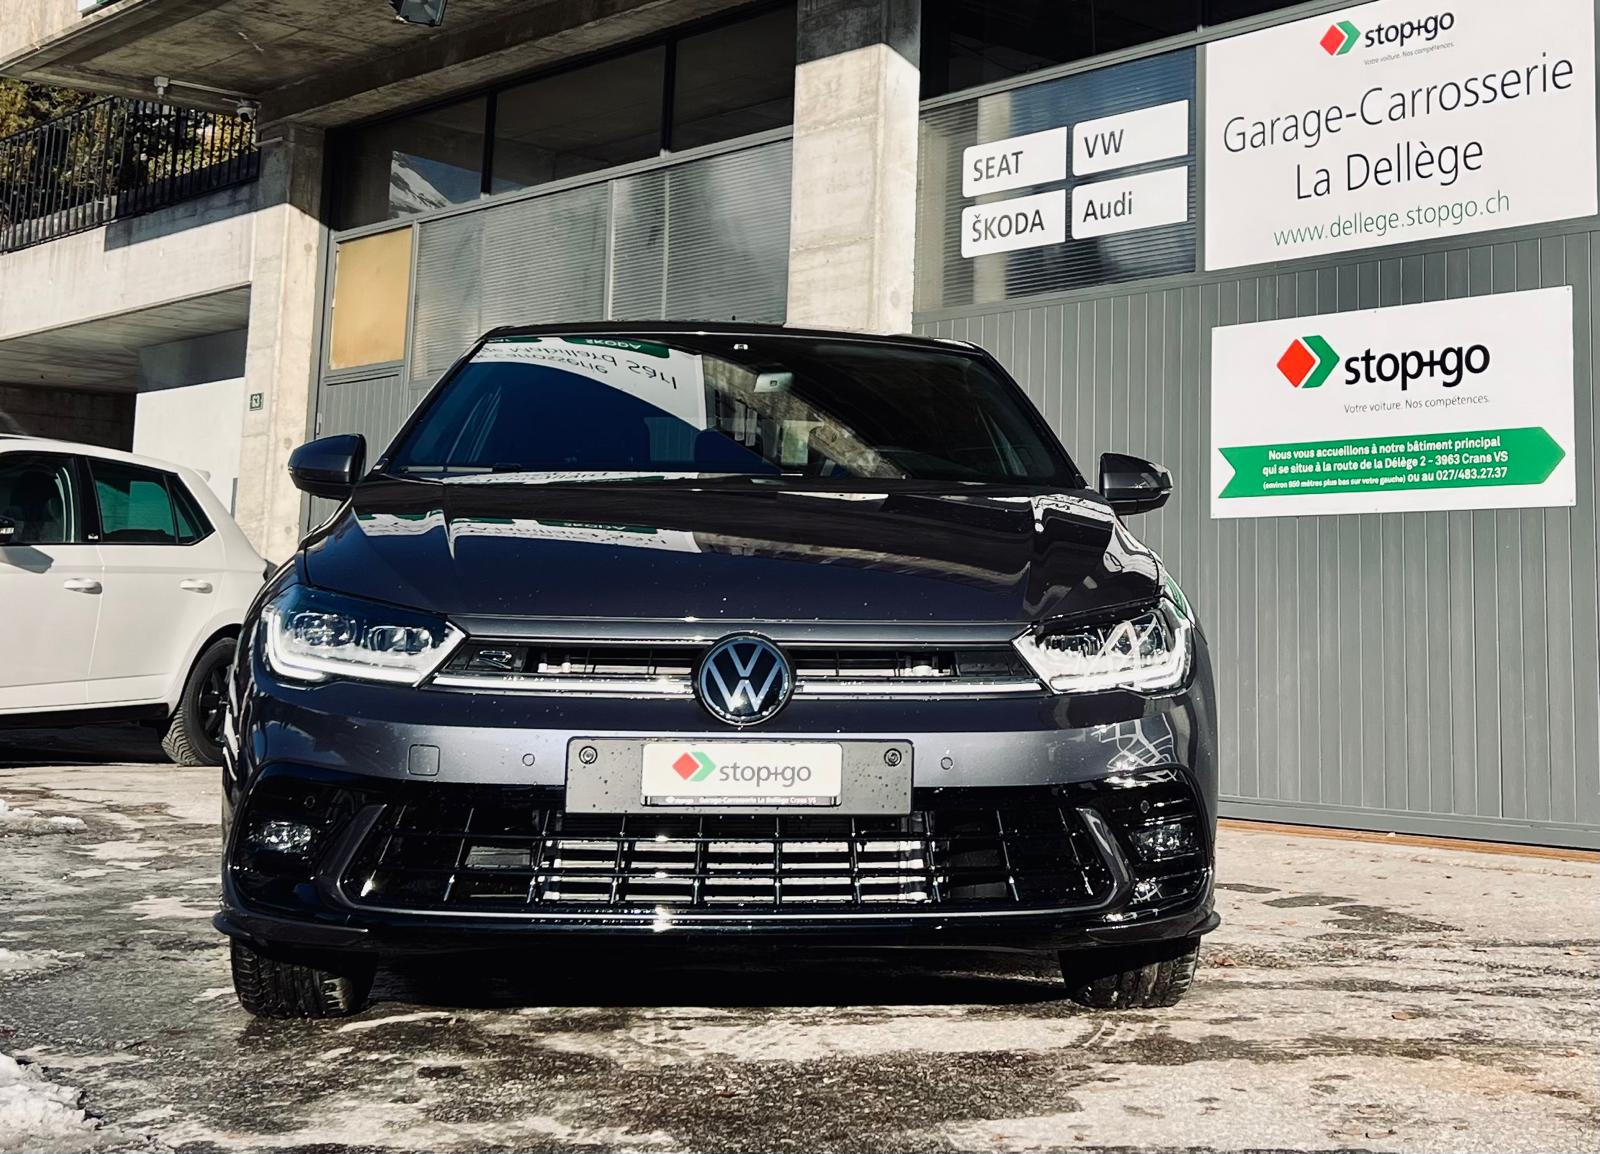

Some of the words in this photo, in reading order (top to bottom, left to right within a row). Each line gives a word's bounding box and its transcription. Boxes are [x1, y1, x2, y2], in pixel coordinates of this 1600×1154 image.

[1364, 12, 1455, 47] stop+go
[1223, 51, 1574, 153] Garage-Carrosserie
[1083, 128, 1125, 158] VW
[972, 150, 1024, 182] SEAT
[1296, 163, 1331, 200] La
[1346, 140, 1484, 191] Dellège
[1082, 190, 1134, 223] Audi
[1273, 189, 1511, 247] www.dellege.stopgo.ch
[971, 208, 1046, 243] ŠKODA
[1344, 343, 1491, 391] stop+go
[1343, 403, 1368, 414] Votre
[1405, 399, 1423, 409] Nos
[1262, 464, 1277, 477] qui
[1278, 465, 1290, 474] se
[1290, 462, 1314, 474] situe
[1315, 461, 1322, 472] à
[1322, 460, 1332, 472] la
[1333, 460, 1359, 471] route
[1359, 458, 1372, 470] de
[1373, 457, 1383, 469] la
[1384, 456, 1419, 470] Délège
[1420, 455, 1427, 466] 2
[1435, 453, 1461, 466] 3963
[1461, 452, 1493, 464] Crans
[1493, 450, 1509, 462] VS
[1268, 449, 1292, 461] Nous
[1293, 448, 1315, 458] vous
[1316, 444, 1370, 458] accueillons
[1371, 443, 1378, 455] à
[1379, 442, 1406, 454] notre
[1407, 439, 1453, 453] bâtiment
[1454, 435, 1501, 451] principal
[1407, 473, 1420, 482] ou
[1421, 472, 1434, 482] au
[1435, 466, 1508, 481] 027/483.27.37
[718, 761, 812, 788] stop+go
